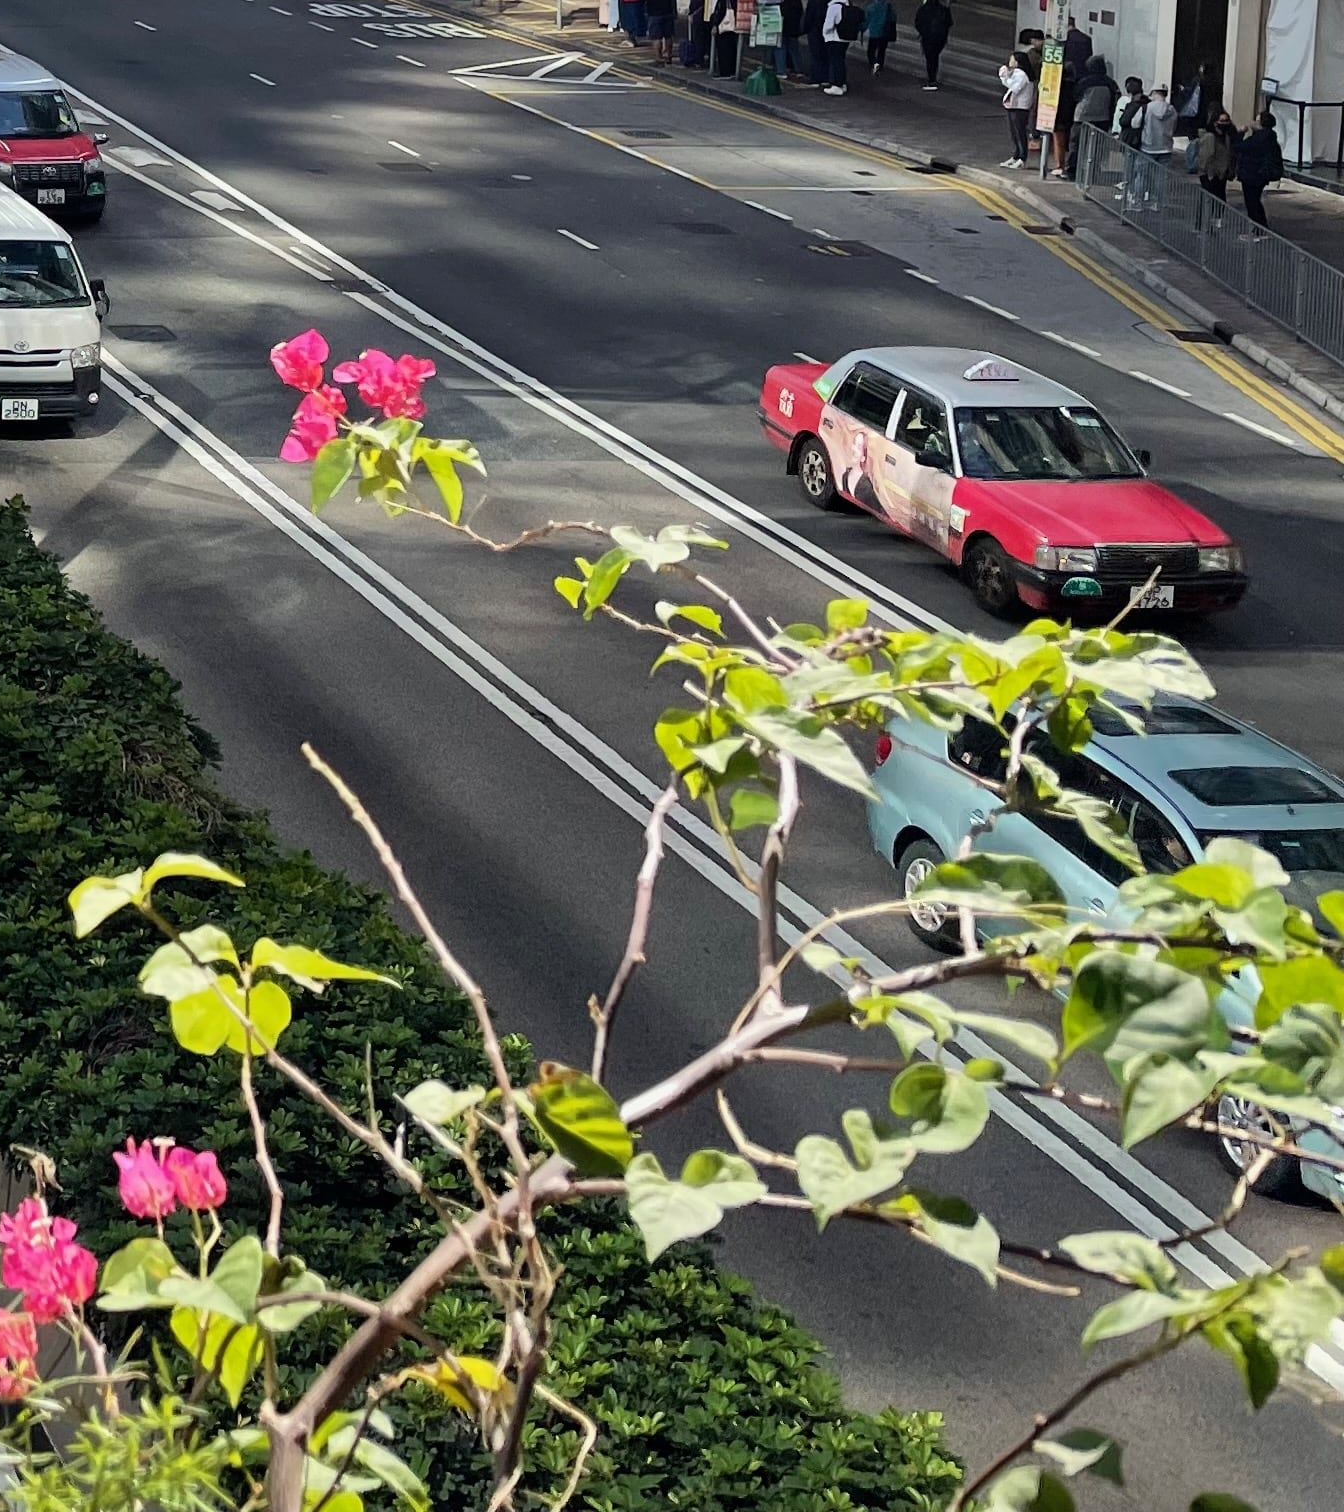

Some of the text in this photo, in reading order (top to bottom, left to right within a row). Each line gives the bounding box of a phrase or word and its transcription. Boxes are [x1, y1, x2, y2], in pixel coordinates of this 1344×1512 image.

[308, 2, 433, 18] STOP
[362, 21, 488, 39] BUS
[1043, 48, 1063, 64] 55
